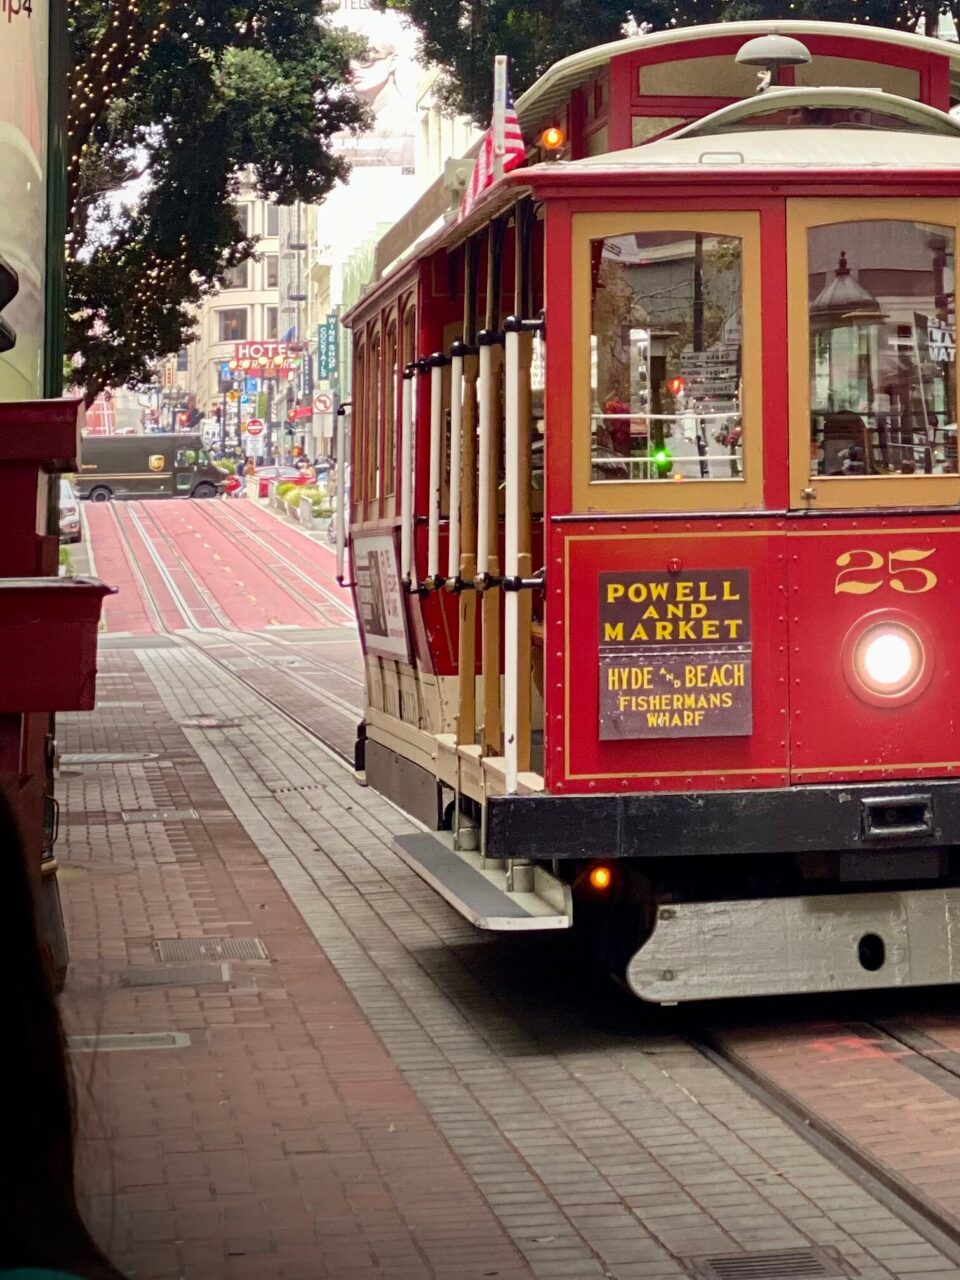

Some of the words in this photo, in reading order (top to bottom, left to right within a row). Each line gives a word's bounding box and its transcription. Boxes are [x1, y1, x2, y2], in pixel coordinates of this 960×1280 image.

[328, 317, 336, 342] WINE
[238, 343, 296, 358] HOTEL
[328, 344, 336, 369] SHOP
[835, 548, 938, 595] 25
[607, 582, 740, 603] POWELL
[643, 604, 708, 619] AND
[604, 620, 743, 641] MARKET
[608, 667, 653, 690] HYDE
[660, 668, 681, 688] AND
[685, 664, 745, 687] BEACH
[620, 693, 732, 711] FISHERMANS
[647, 712, 705, 727] WHARF
